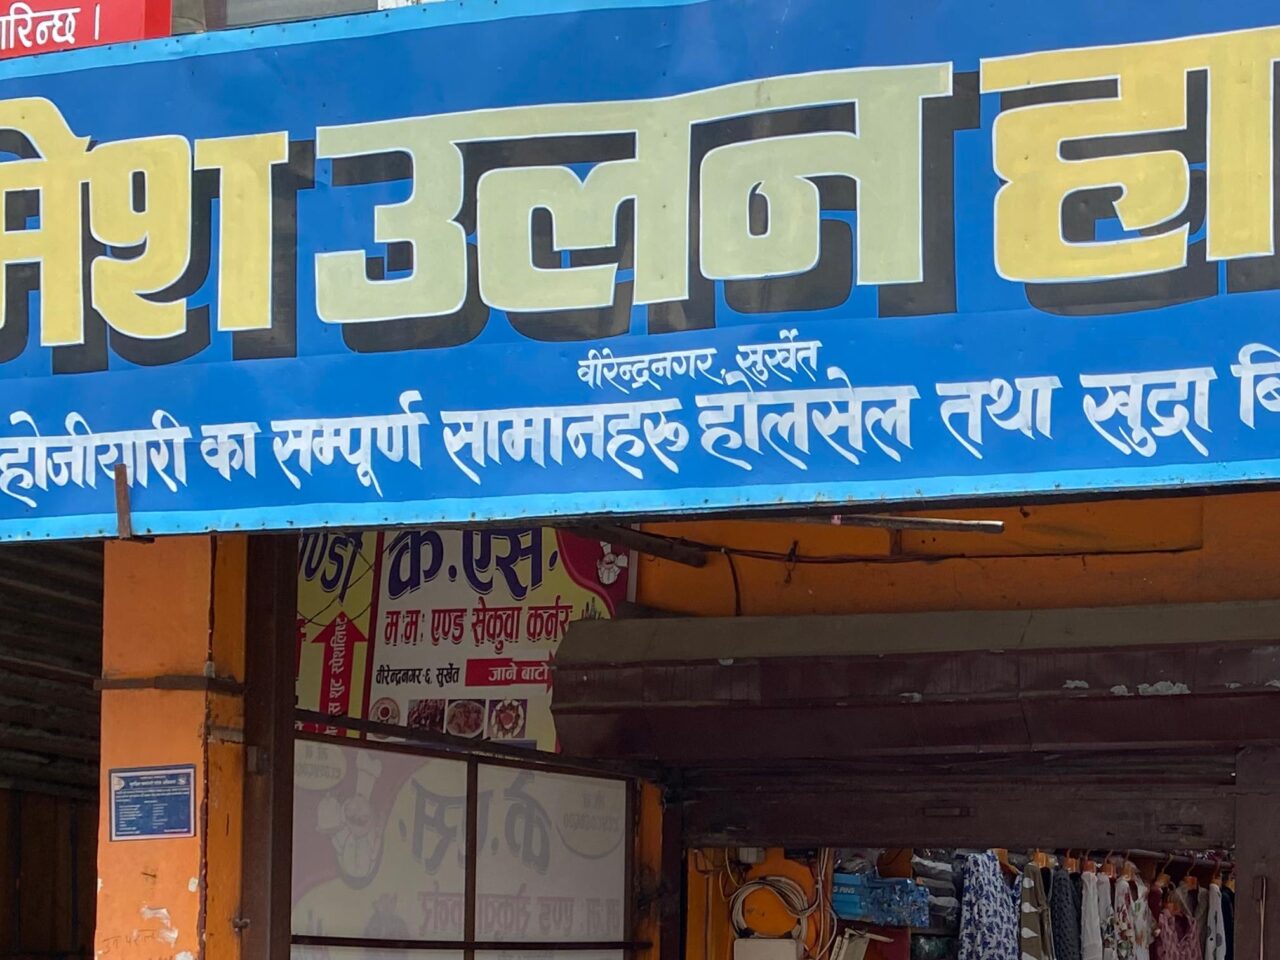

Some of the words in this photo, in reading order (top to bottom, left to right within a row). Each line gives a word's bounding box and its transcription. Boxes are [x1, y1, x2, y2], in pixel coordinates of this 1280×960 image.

[317, 62, 952, 325] उलन
[200, 421, 262, 482] का
[271, 390, 430, 498] सम्पूर्ण
[695, 366, 920, 471] होलसेल
[935, 376, 1063, 460] तथा
[1079, 366, 1219, 457] खुद्रा
[430, 608, 467, 646] एण्ड
[471, 596, 523, 654] सेकुवा
[488, 662, 518, 681] जाने
